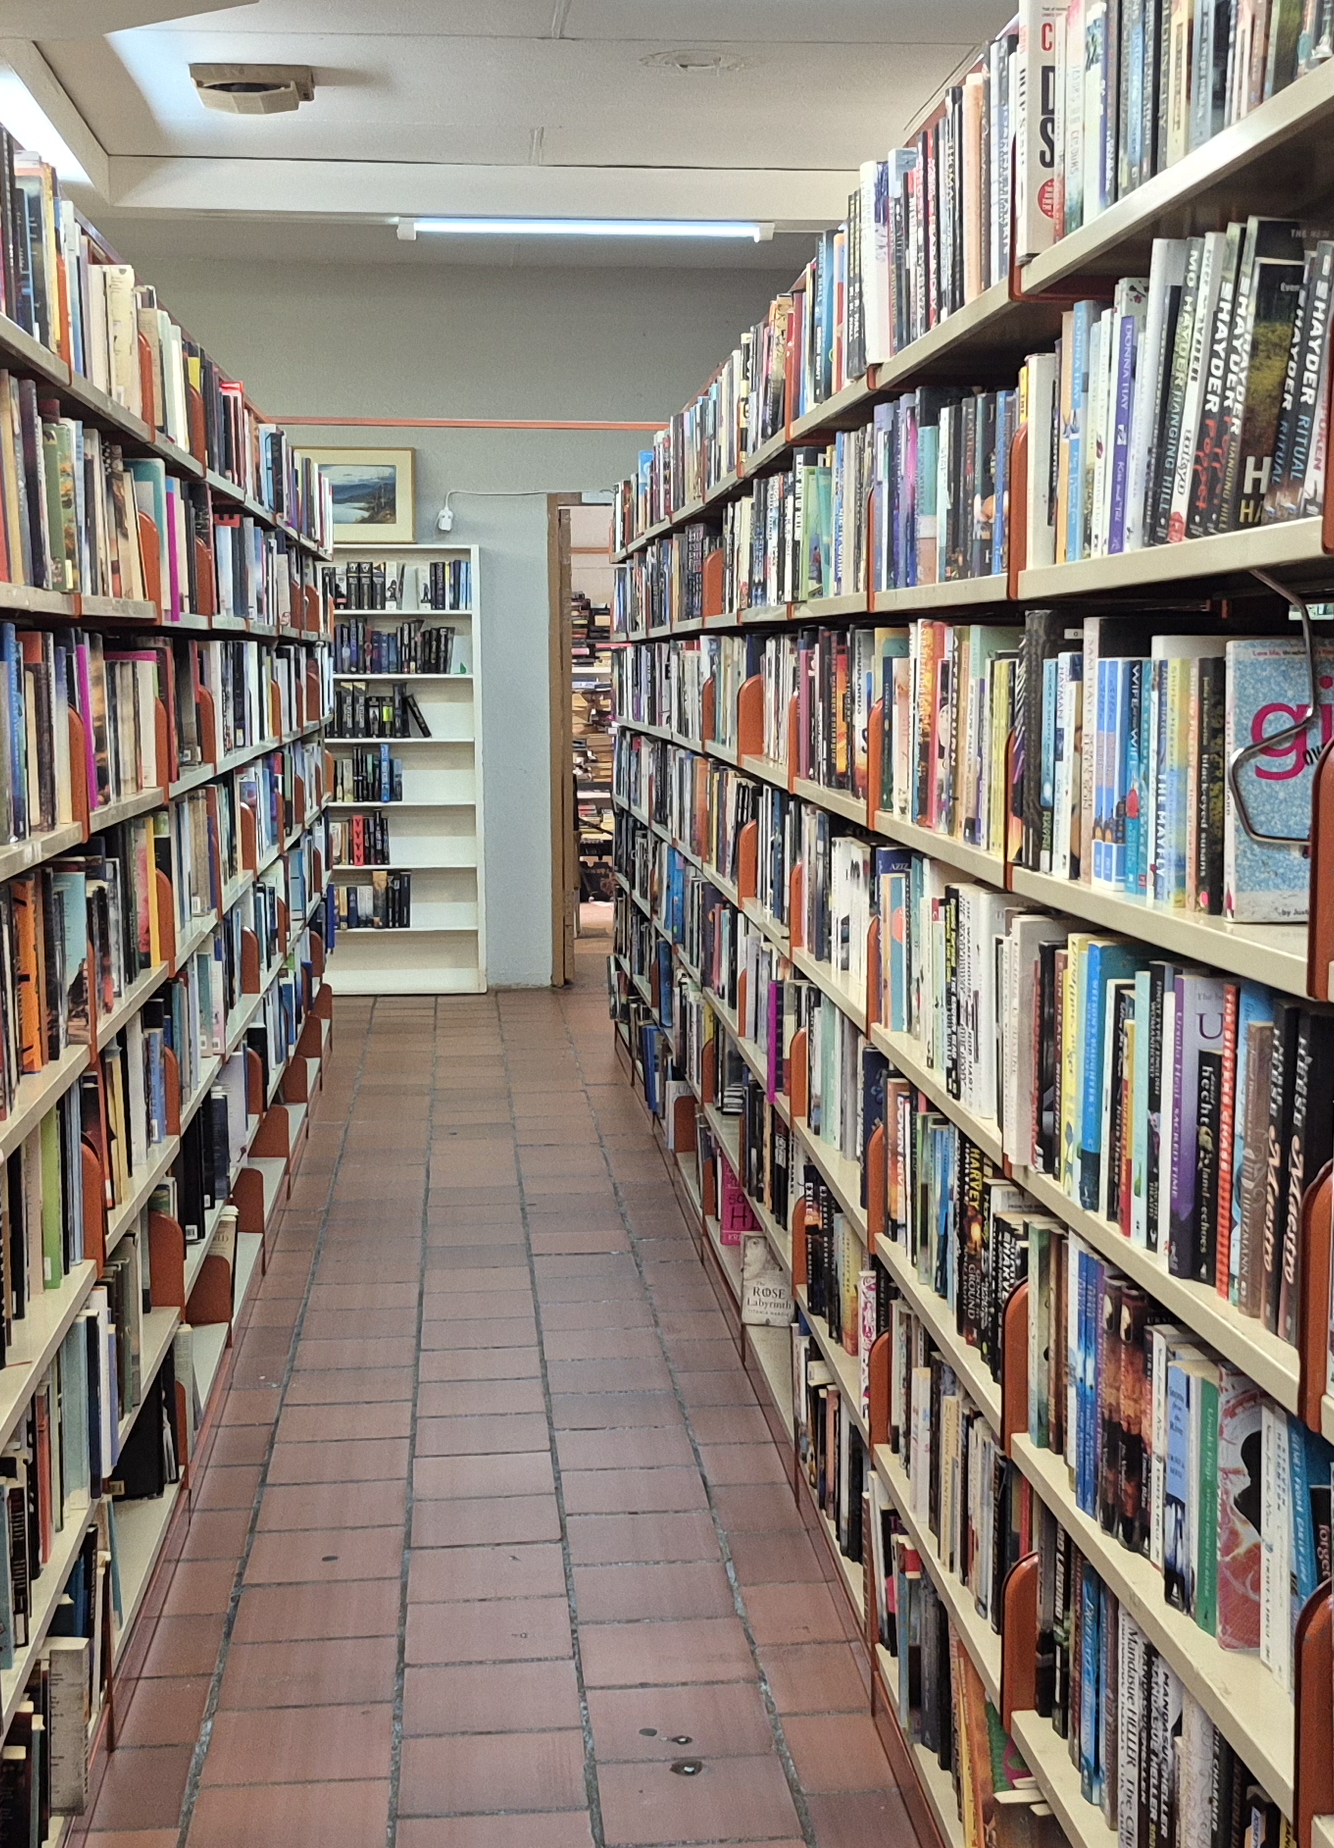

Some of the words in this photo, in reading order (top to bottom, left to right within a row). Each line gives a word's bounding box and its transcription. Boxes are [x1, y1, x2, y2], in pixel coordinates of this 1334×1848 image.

[1121, 323, 1133, 379] DONNA
[1175, 294, 1194, 387] HAYDER
[1204, 300, 1231, 414] HAYDER
[1281, 308, 1304, 411] HAYDER
[1299, 300, 1326, 405] HAYDER
[1119, 382, 1130, 411] HAY
[1164, 389, 1183, 469] HANGING
[1271, 420, 1289, 484] RITUAL
[1290, 414, 1310, 481] RITUAL
[1158, 475, 1173, 513] HILL
[1130, 665, 1141, 707] WIFE
[1198, 754, 1210, 828] black-eyed
[1199, 1065, 1212, 1125] hecht
[1220, 1110, 1231, 1172] CHASE
[968, 1147, 982, 1210] HARVEY
[1261, 1125, 1281, 1272] Maestro
[1282, 1135, 1304, 1285] Maestro
[747, 1297, 792, 1310] Labyrinth
[753, 1287, 786, 1299] ROSE
[966, 1263, 980, 1321] GROUND
[1126, 1627, 1139, 1706] Mandasue
